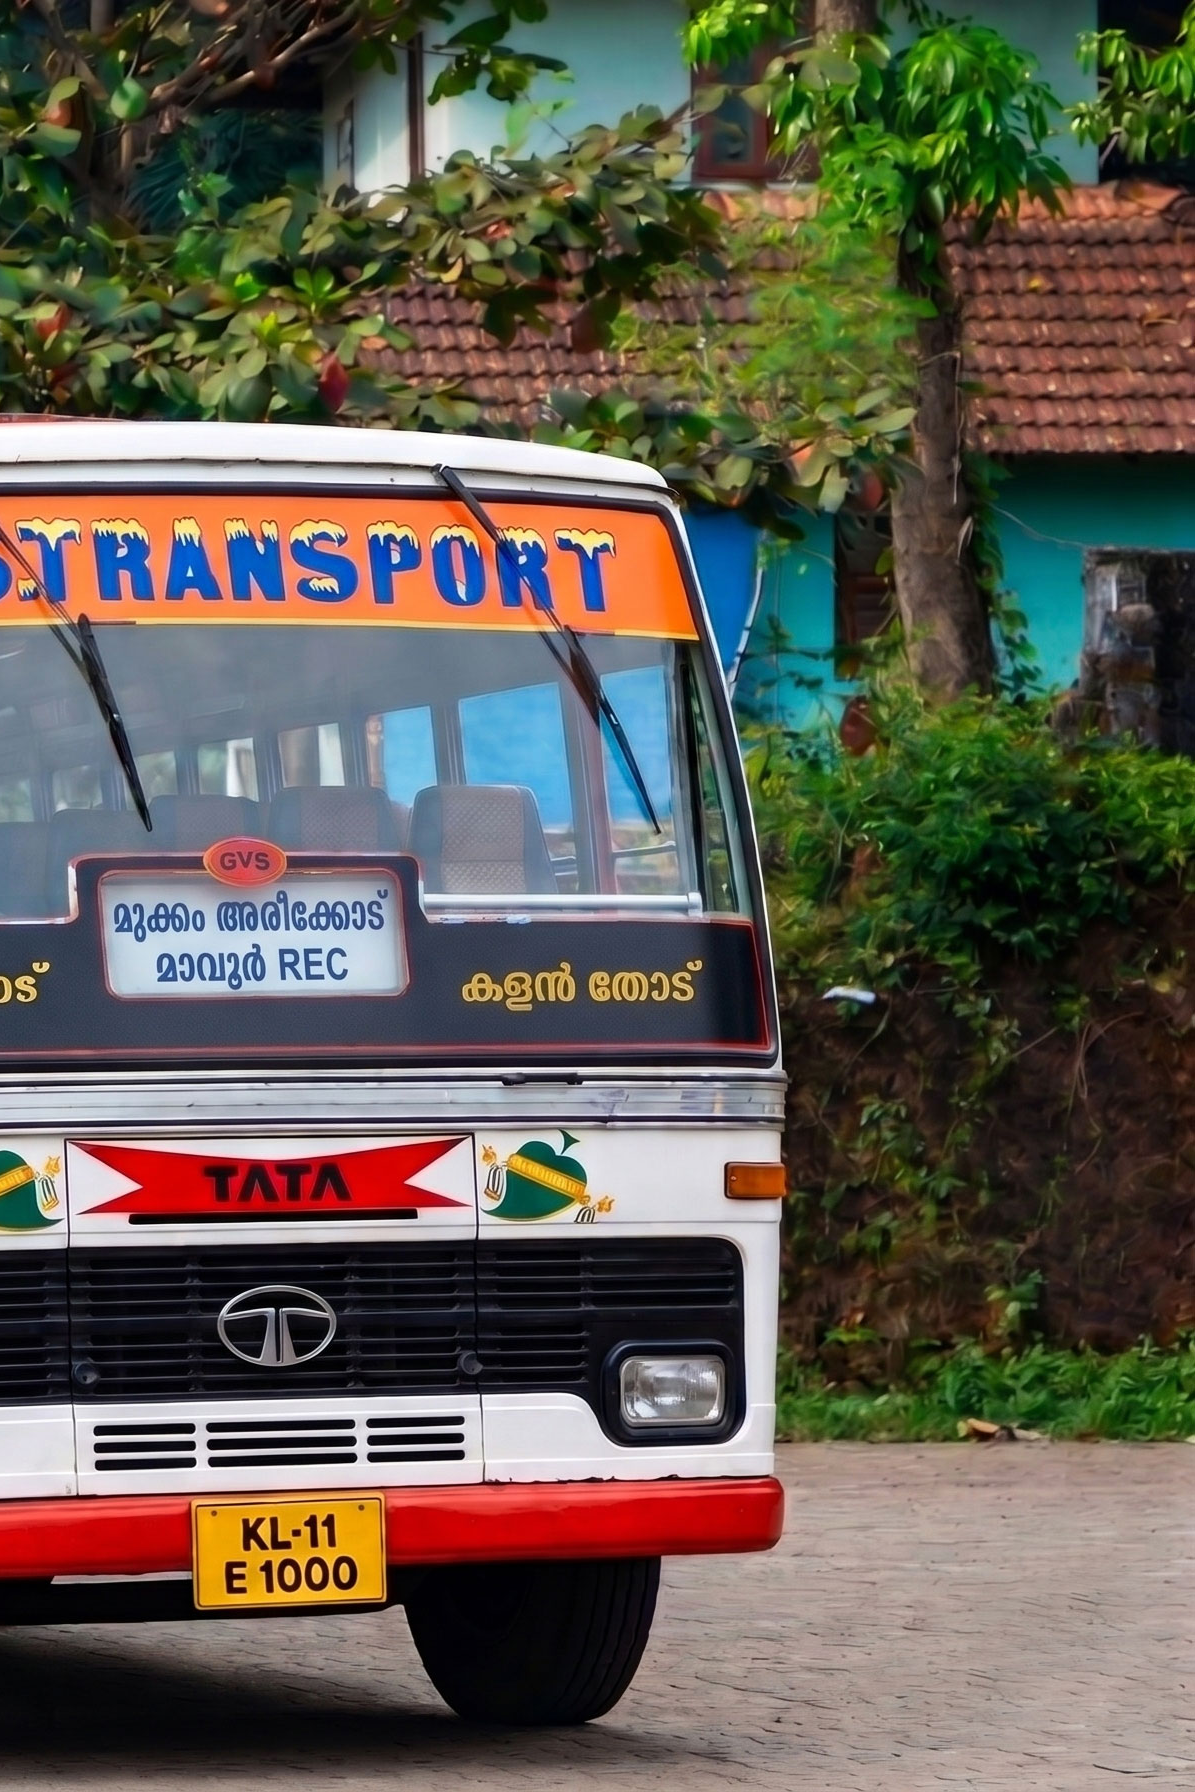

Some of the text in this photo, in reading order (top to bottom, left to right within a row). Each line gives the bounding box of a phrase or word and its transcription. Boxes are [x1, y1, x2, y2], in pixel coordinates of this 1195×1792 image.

[219, 851, 271, 871] GVS
[113, 889, 389, 943] മുക്കം അരീക്കോട്
[156, 943, 349, 990] മാവൂർ REC
[588, 959, 703, 1001] തോട്
[203, 1163, 354, 1203] TATA
[241, 1514, 337, 1552] KL-11
[225, 1555, 358, 1595] E 1000
